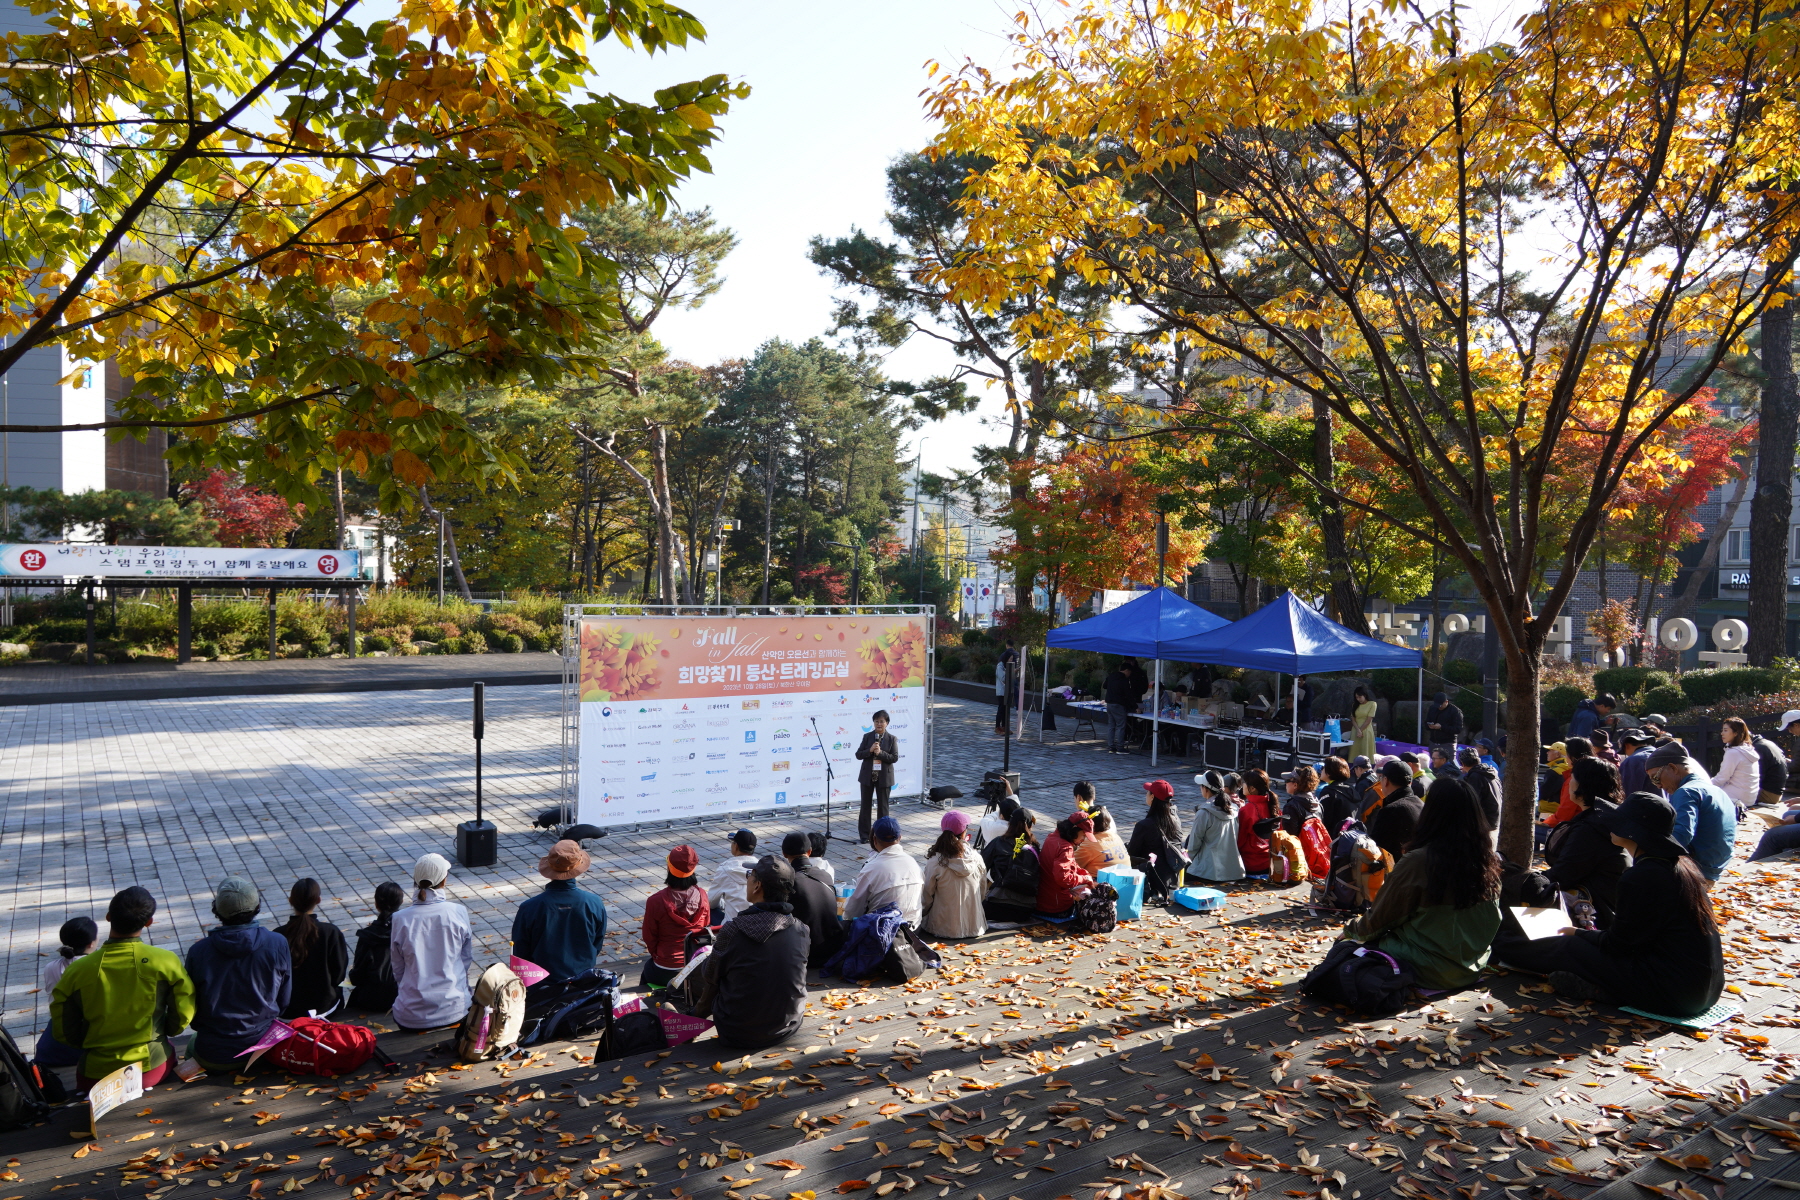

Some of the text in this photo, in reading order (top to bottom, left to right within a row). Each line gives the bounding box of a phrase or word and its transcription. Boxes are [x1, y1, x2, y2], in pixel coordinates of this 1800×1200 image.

[58, 547, 186, 558] 너랑! 나랑! 우리랑!
[24, 552, 42, 568] 환
[225, 560, 251, 569] 함께
[255, 560, 308, 569] 출발해요
[319, 557, 335, 573] 영
[692, 626, 737, 648] Fall
[708, 632, 771, 663] in fall
[761, 648, 847, 660] 산악인 오은선과 함께하는
[678, 665, 741, 684] 희망찾기
[773, 732, 791, 741] paleo
[664, 1022, 706, 1033] 등산 트레킹교실
